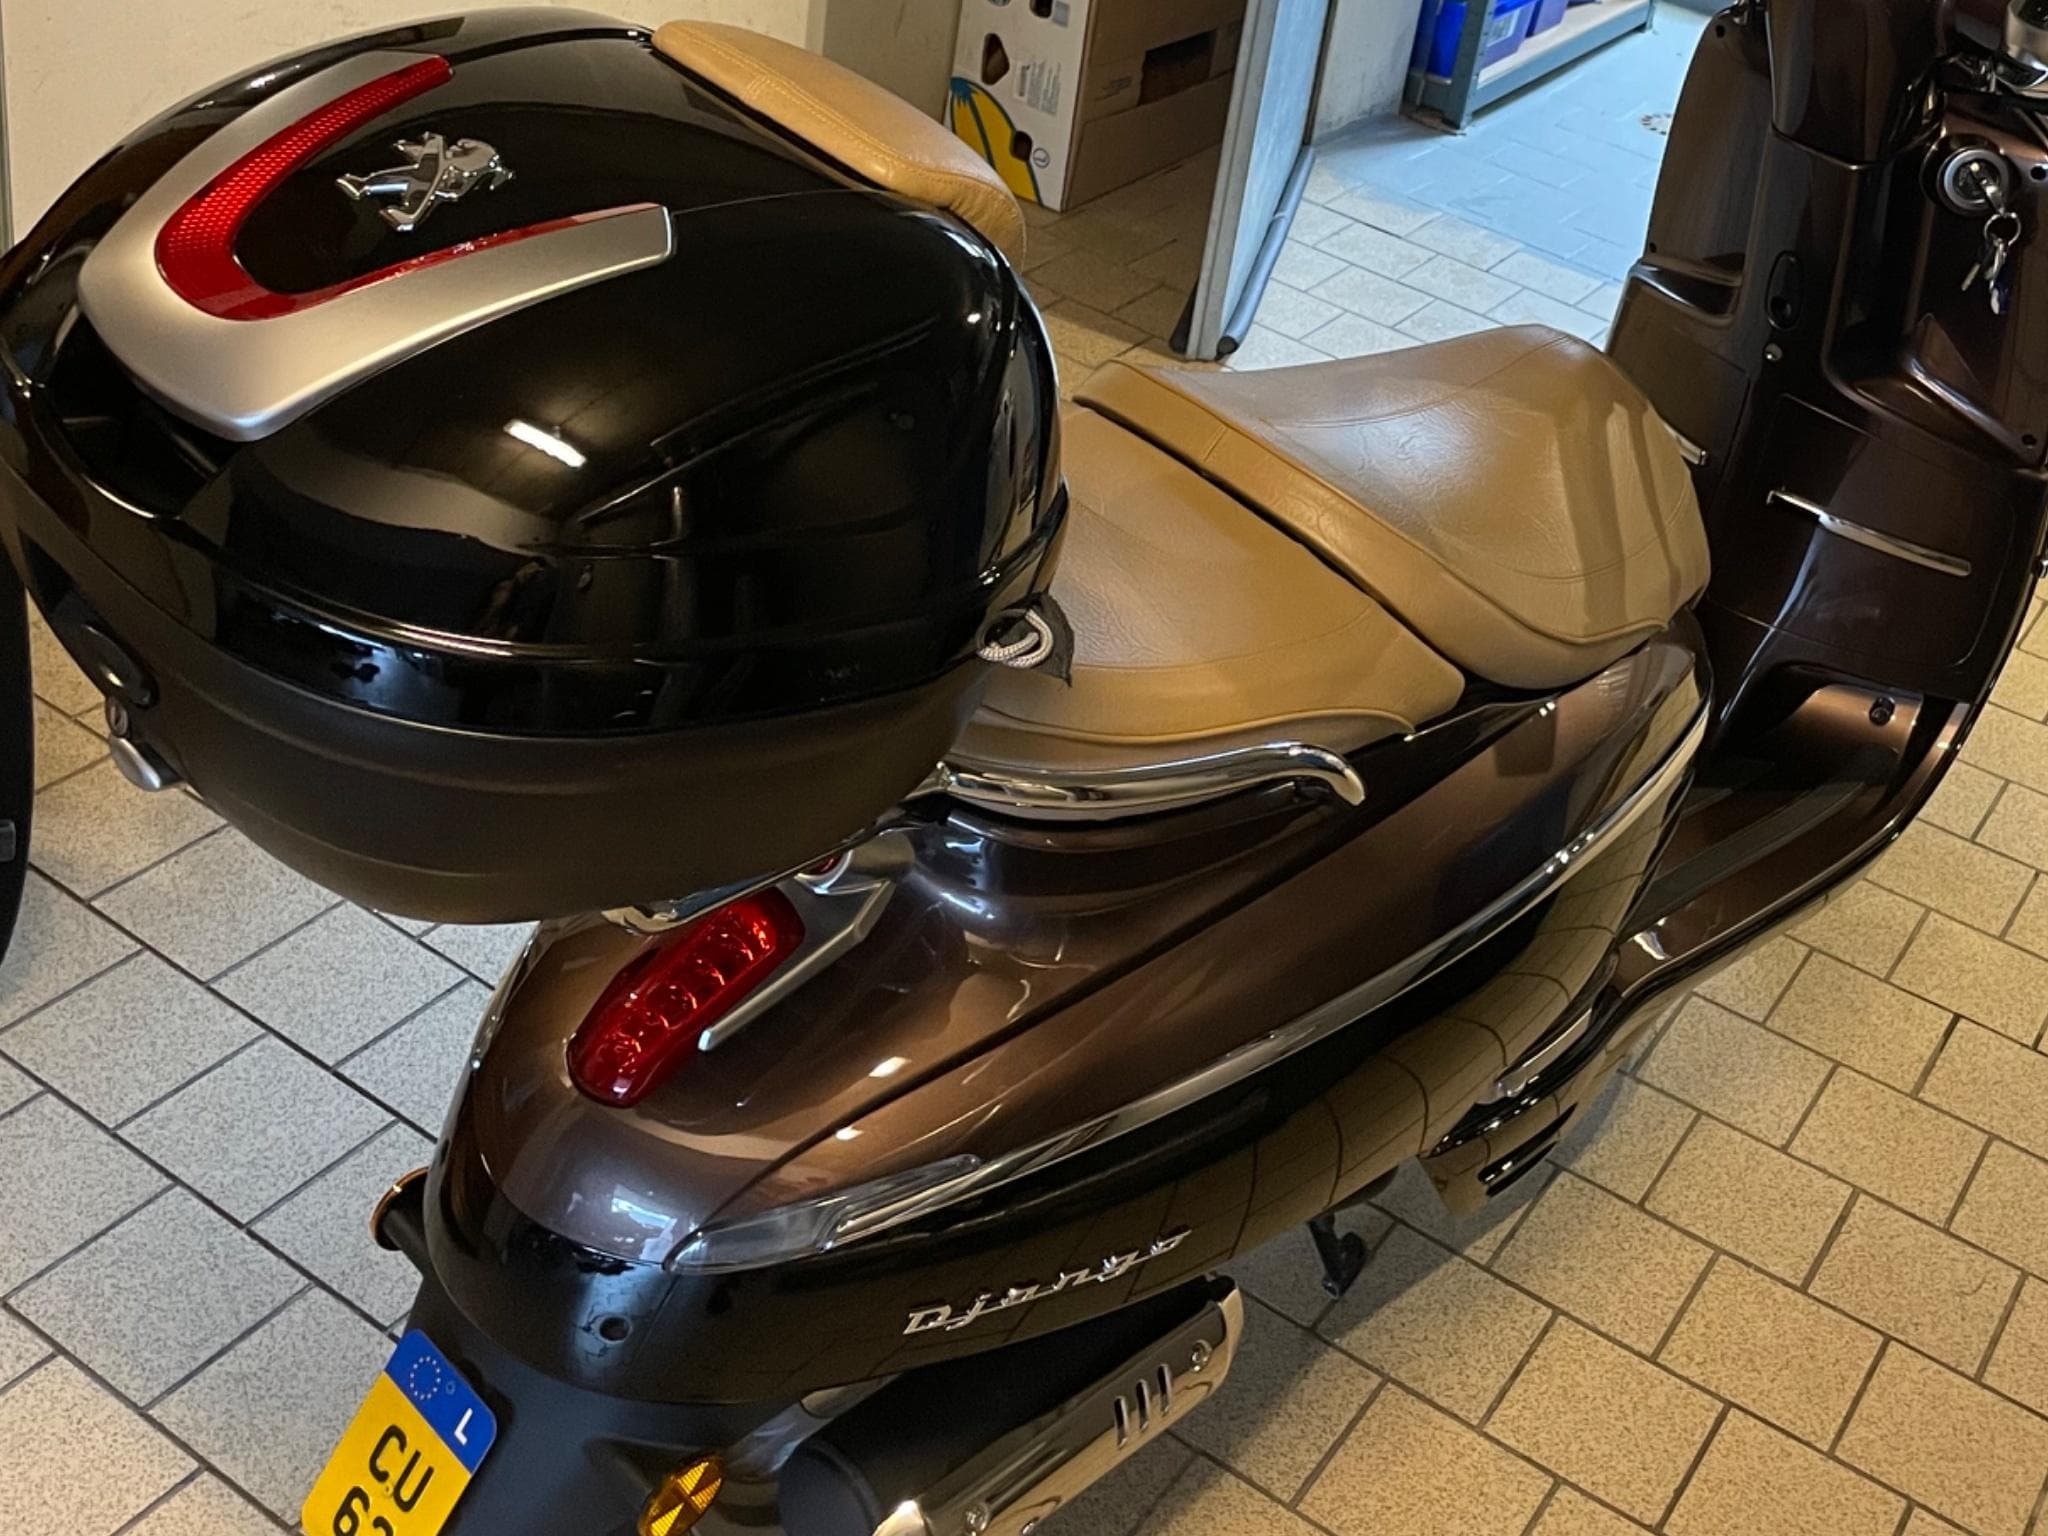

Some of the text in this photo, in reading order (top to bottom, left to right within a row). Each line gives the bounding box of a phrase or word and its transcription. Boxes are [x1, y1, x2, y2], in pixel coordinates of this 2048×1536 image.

[902, 1229, 1193, 1335] Django
[368, 1424, 435, 1513] CU
[454, 1407, 473, 1446] L
